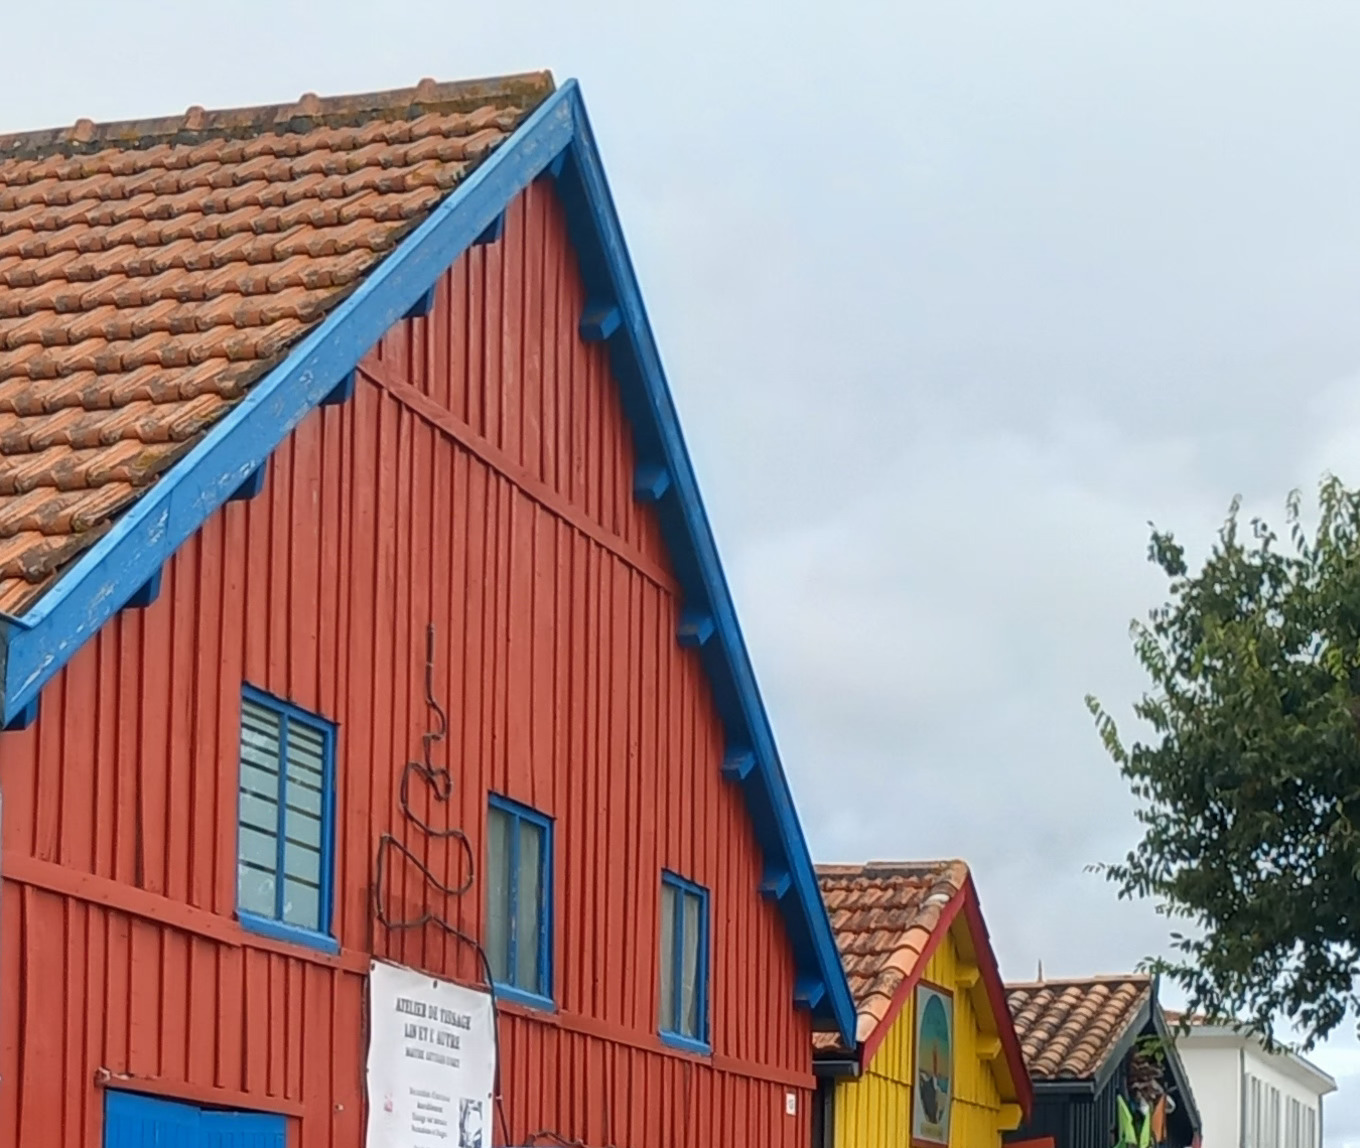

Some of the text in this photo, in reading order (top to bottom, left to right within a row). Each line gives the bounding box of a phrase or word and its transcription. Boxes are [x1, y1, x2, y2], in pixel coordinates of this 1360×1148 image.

[395, 997, 472, 1031] ATELIER DE TISSAGE
